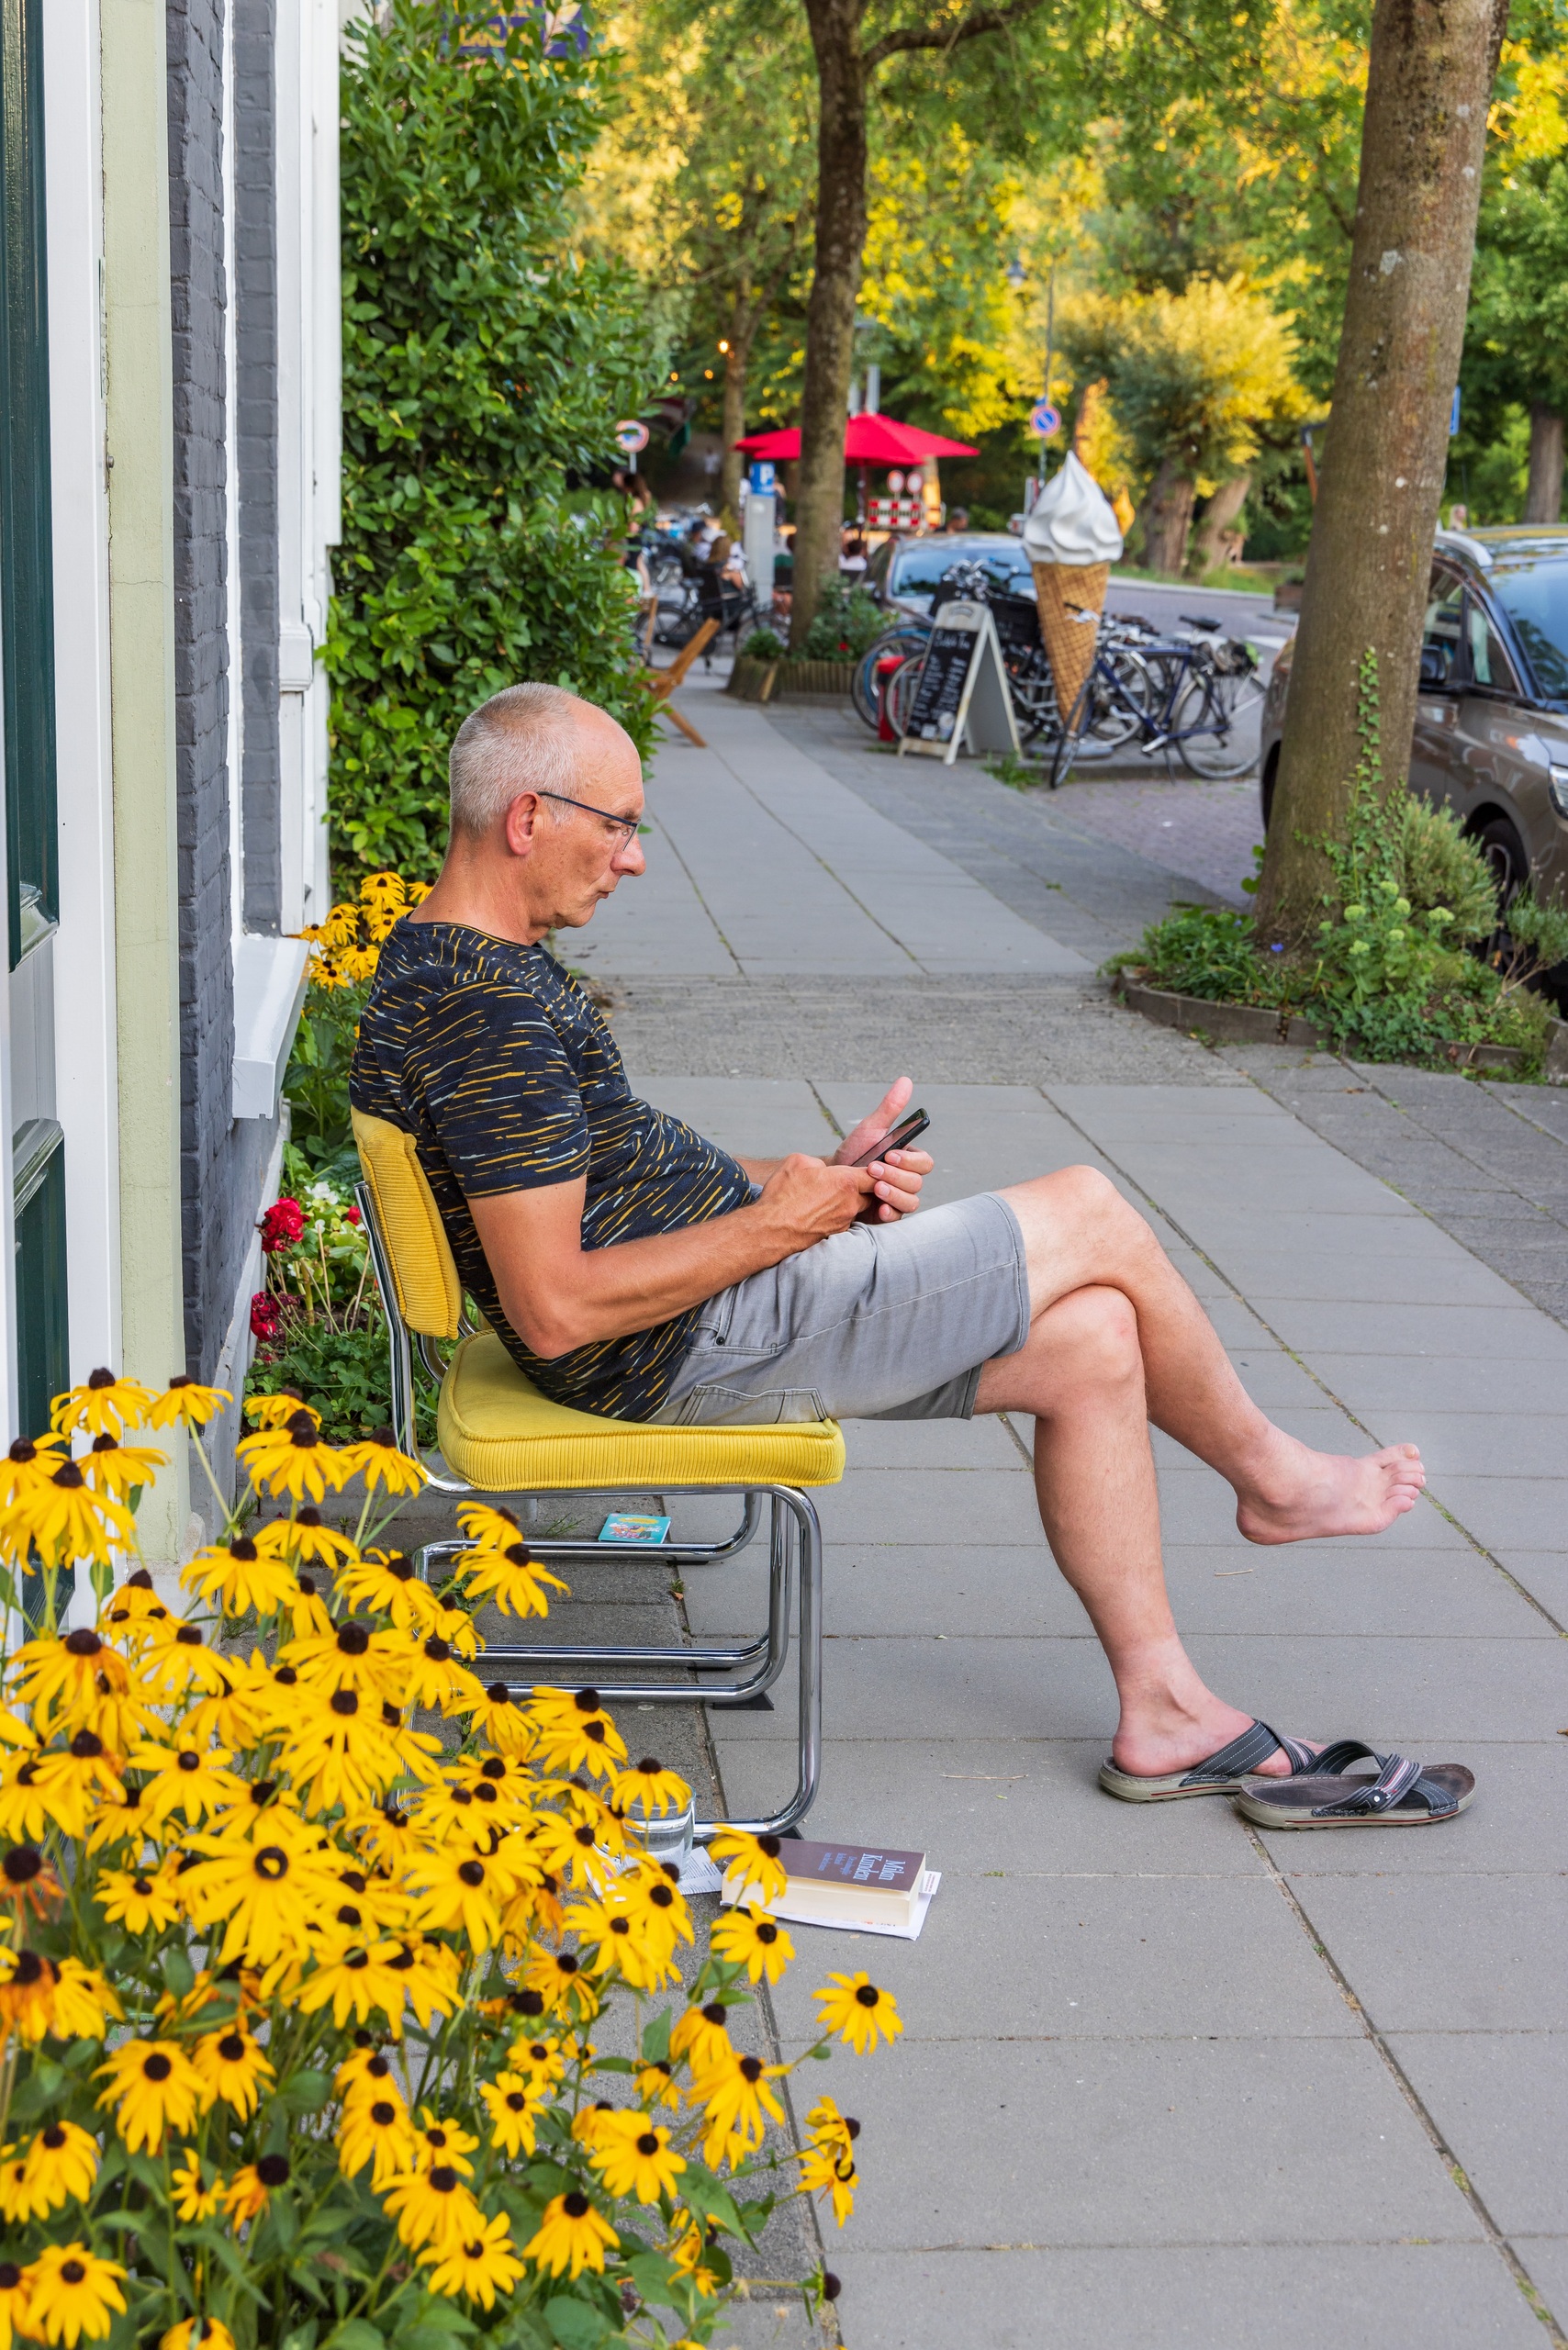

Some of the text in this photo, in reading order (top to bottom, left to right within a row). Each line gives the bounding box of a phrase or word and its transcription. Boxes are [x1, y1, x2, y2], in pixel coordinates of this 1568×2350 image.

[760, 464, 775, 485] P
[853, 1852, 883, 1880] Kundera
[879, 1859, 906, 1880] Milan
